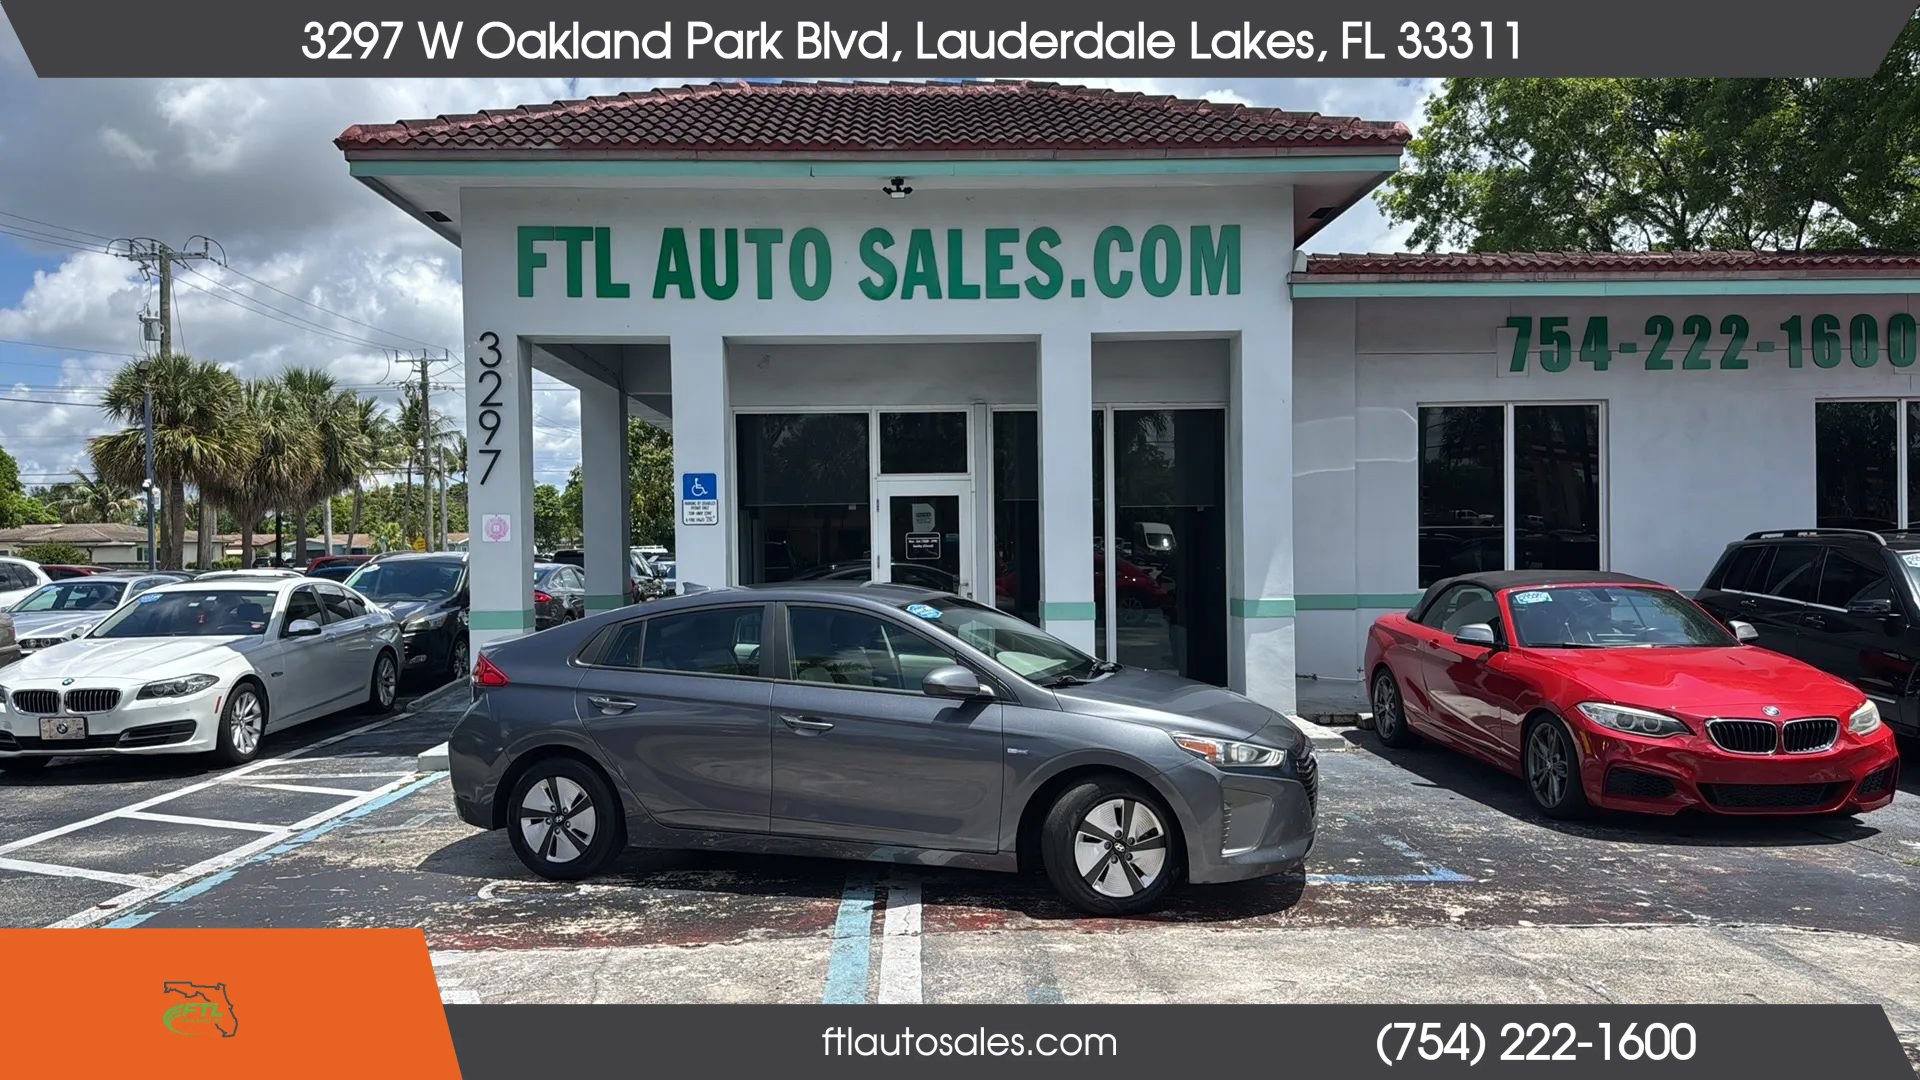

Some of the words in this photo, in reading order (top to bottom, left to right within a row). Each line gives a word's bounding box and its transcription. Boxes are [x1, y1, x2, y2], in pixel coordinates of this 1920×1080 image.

[516, 226, 631, 300] FTL
[652, 226, 834, 302] AUTO
[857, 224, 1243, 303] SALES.COM
[1506, 312, 1918, 373] 754-222-1600
[478, 331, 503, 486] 3297
